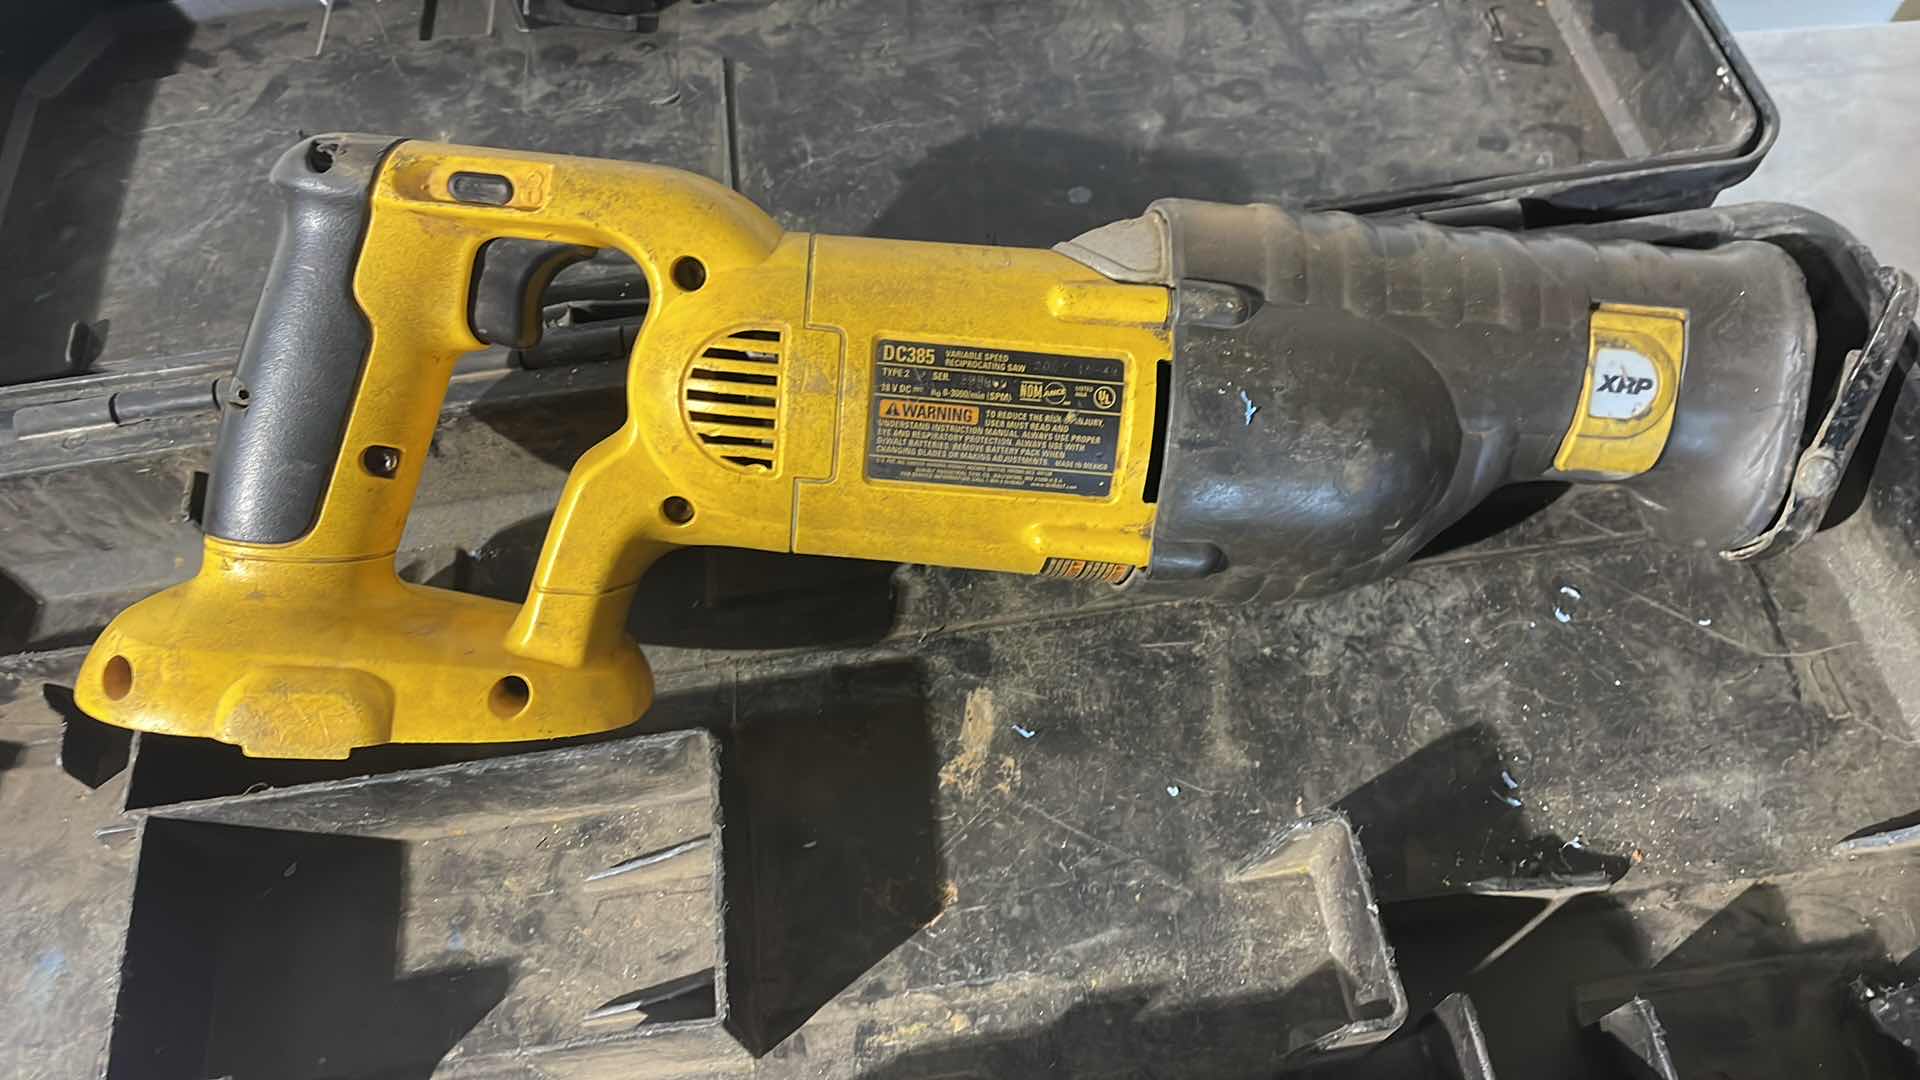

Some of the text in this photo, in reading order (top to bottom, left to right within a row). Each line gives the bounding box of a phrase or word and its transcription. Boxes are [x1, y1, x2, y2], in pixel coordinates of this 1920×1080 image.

[883, 345, 935, 365] DC385
[945, 350, 1009, 362] VARIABLE SPEED
[881, 367, 911, 378] TYPE 2
[945, 358, 1006, 371] RECIPROCATING
[1007, 363, 1026, 373] SAW
[1596, 374, 1654, 395] XRP
[987, 391, 1012, 403] (SPM)
[1098, 390, 1112, 406] UL
[902, 403, 972, 423] WARNING
[985, 410, 996, 418] TO
[997, 411, 1027, 421] REDUCE
[1028, 414, 1044, 422] THE
[1045, 414, 1062, 423] RISK
[879, 420, 930, 430] UNDERSTAND
[931, 424, 984, 434] INSTRUCTION
[1020, 430, 1053, 439] ALWAYS
[1054, 433, 1069, 441] USE
[1071, 434, 1101, 444] PROPER
[985, 419, 1070, 432] USER MUST READ AND
[878, 428, 893, 436] EYE
[893, 429, 910, 437] AND
[911, 430, 963, 441] RESPIRATORY
[1015, 439, 1047, 449] ALWAYS
[1048, 441, 1063, 450] USE
[1064, 443, 1086, 451] WITH
[876, 445, 917, 454] CHANGING
[918, 448, 946, 457] BLADES
[948, 450, 959, 458] OR
[960, 452, 991, 461] MAKING
[952, 442, 984, 452] REMOVE
[985, 446, 1020, 455] BATTERY
[1020, 448, 1040, 456] PACK
[1041, 449, 1066, 459] WHEN
